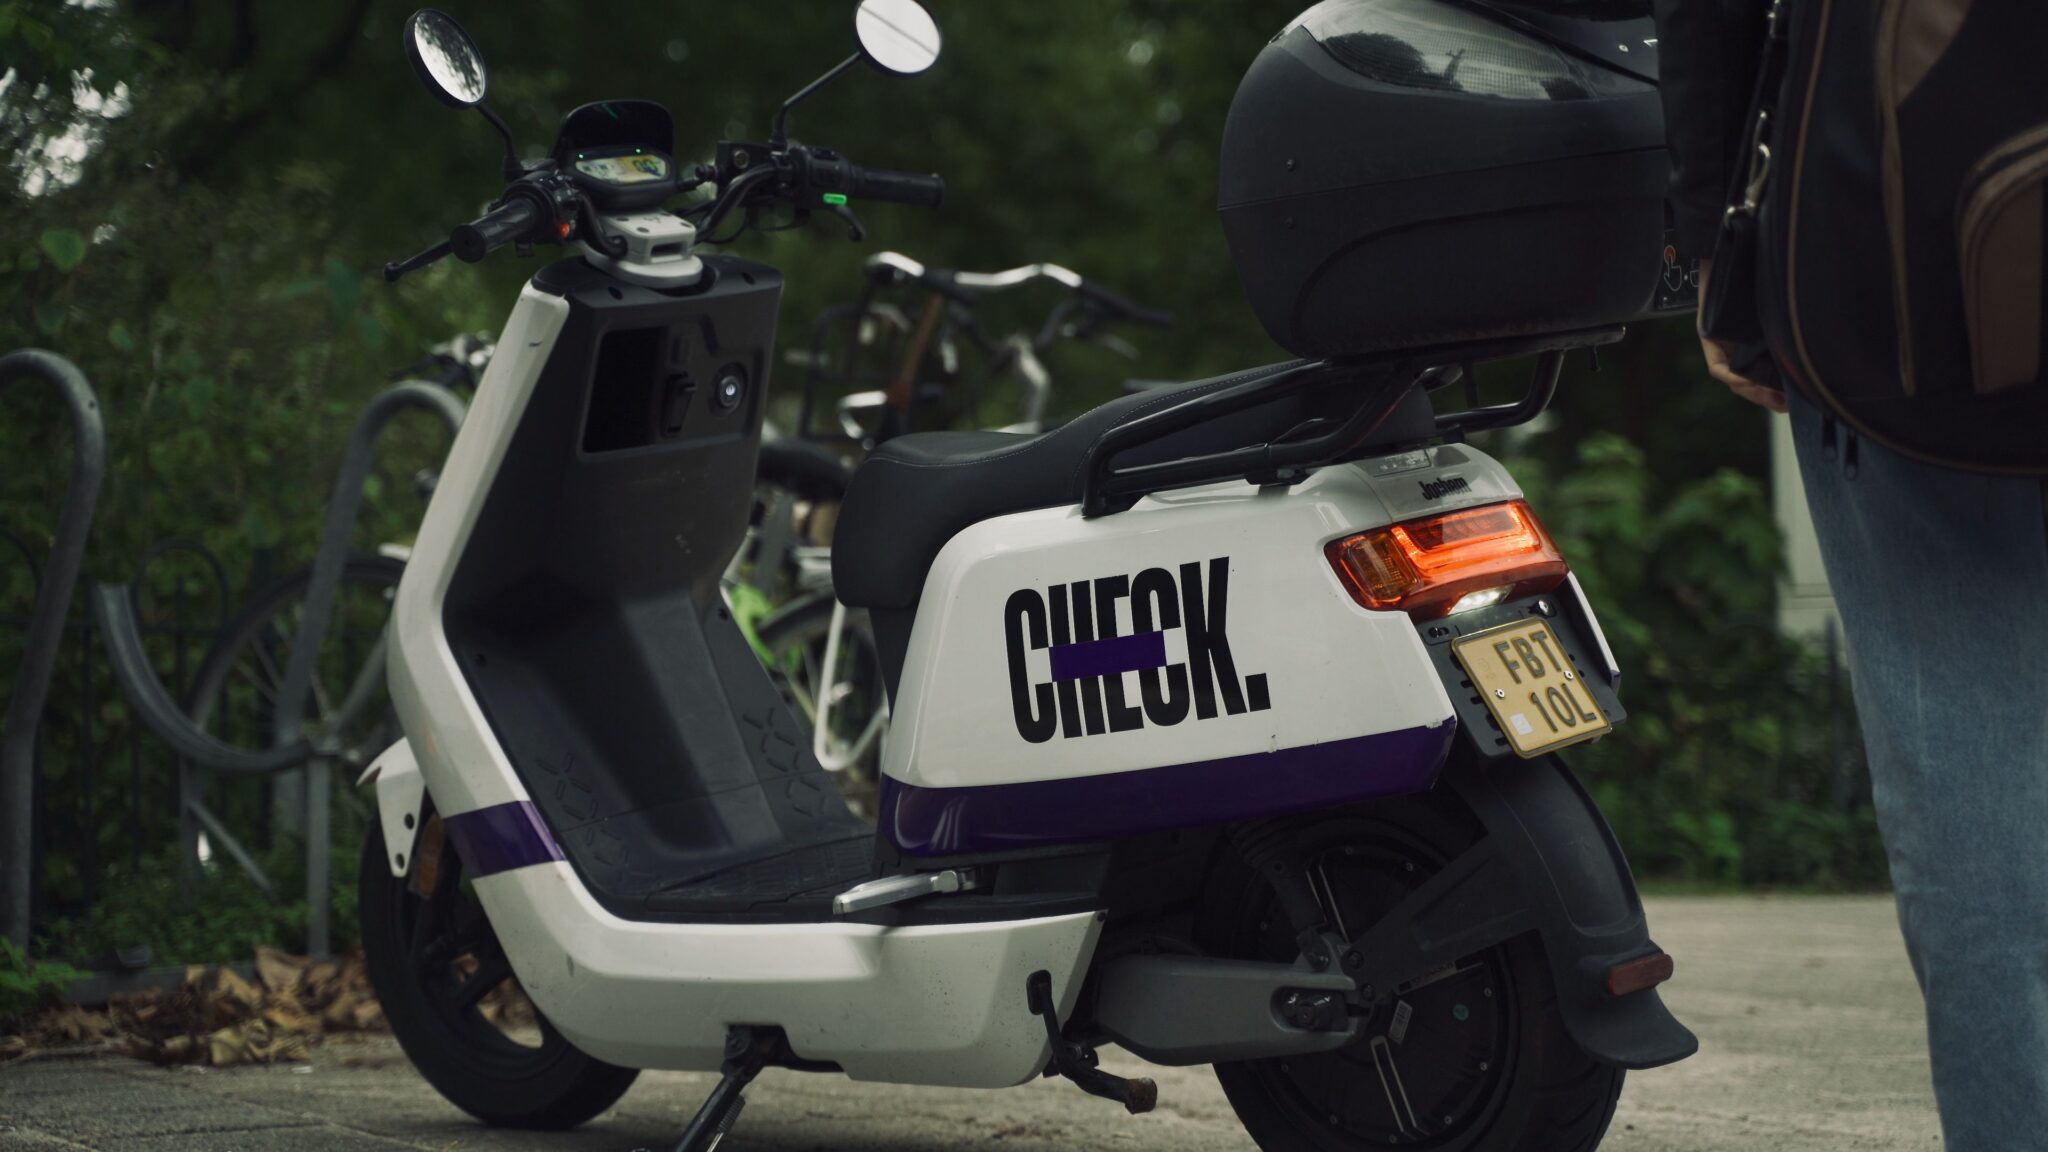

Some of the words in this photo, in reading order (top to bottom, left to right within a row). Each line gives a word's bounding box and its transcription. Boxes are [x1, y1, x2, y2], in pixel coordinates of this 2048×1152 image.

[1004, 556, 1271, 743] CHECK.
[1493, 630, 1562, 684] FBT
[1529, 683, 1598, 733] 10L
